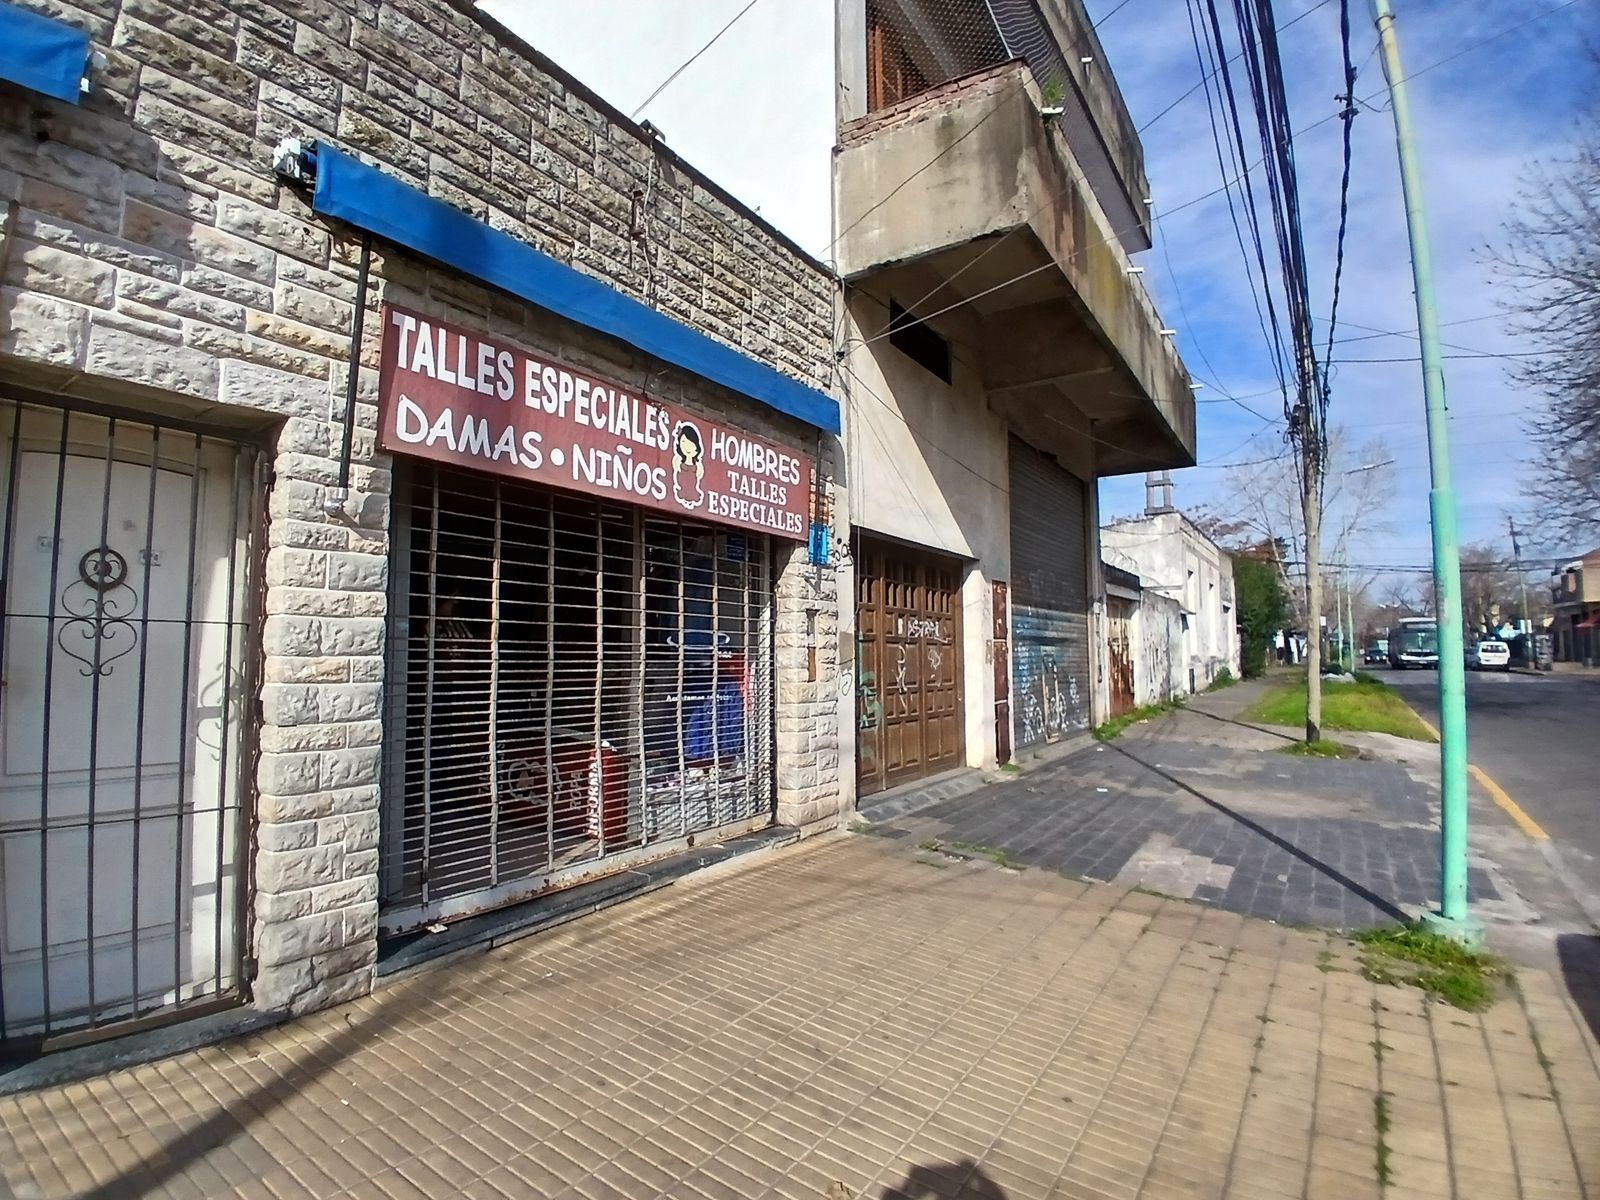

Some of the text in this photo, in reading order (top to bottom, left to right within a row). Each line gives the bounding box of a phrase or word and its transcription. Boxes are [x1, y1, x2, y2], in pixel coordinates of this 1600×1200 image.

[392, 311, 670, 451] TALLES ESPECIALES
[396, 394, 667, 500] DAMAS NIÑOS
[711, 428, 800, 485] HOMBRES
[708, 490, 803, 533] ESPECIALES
[727, 470, 787, 506] TALLES
